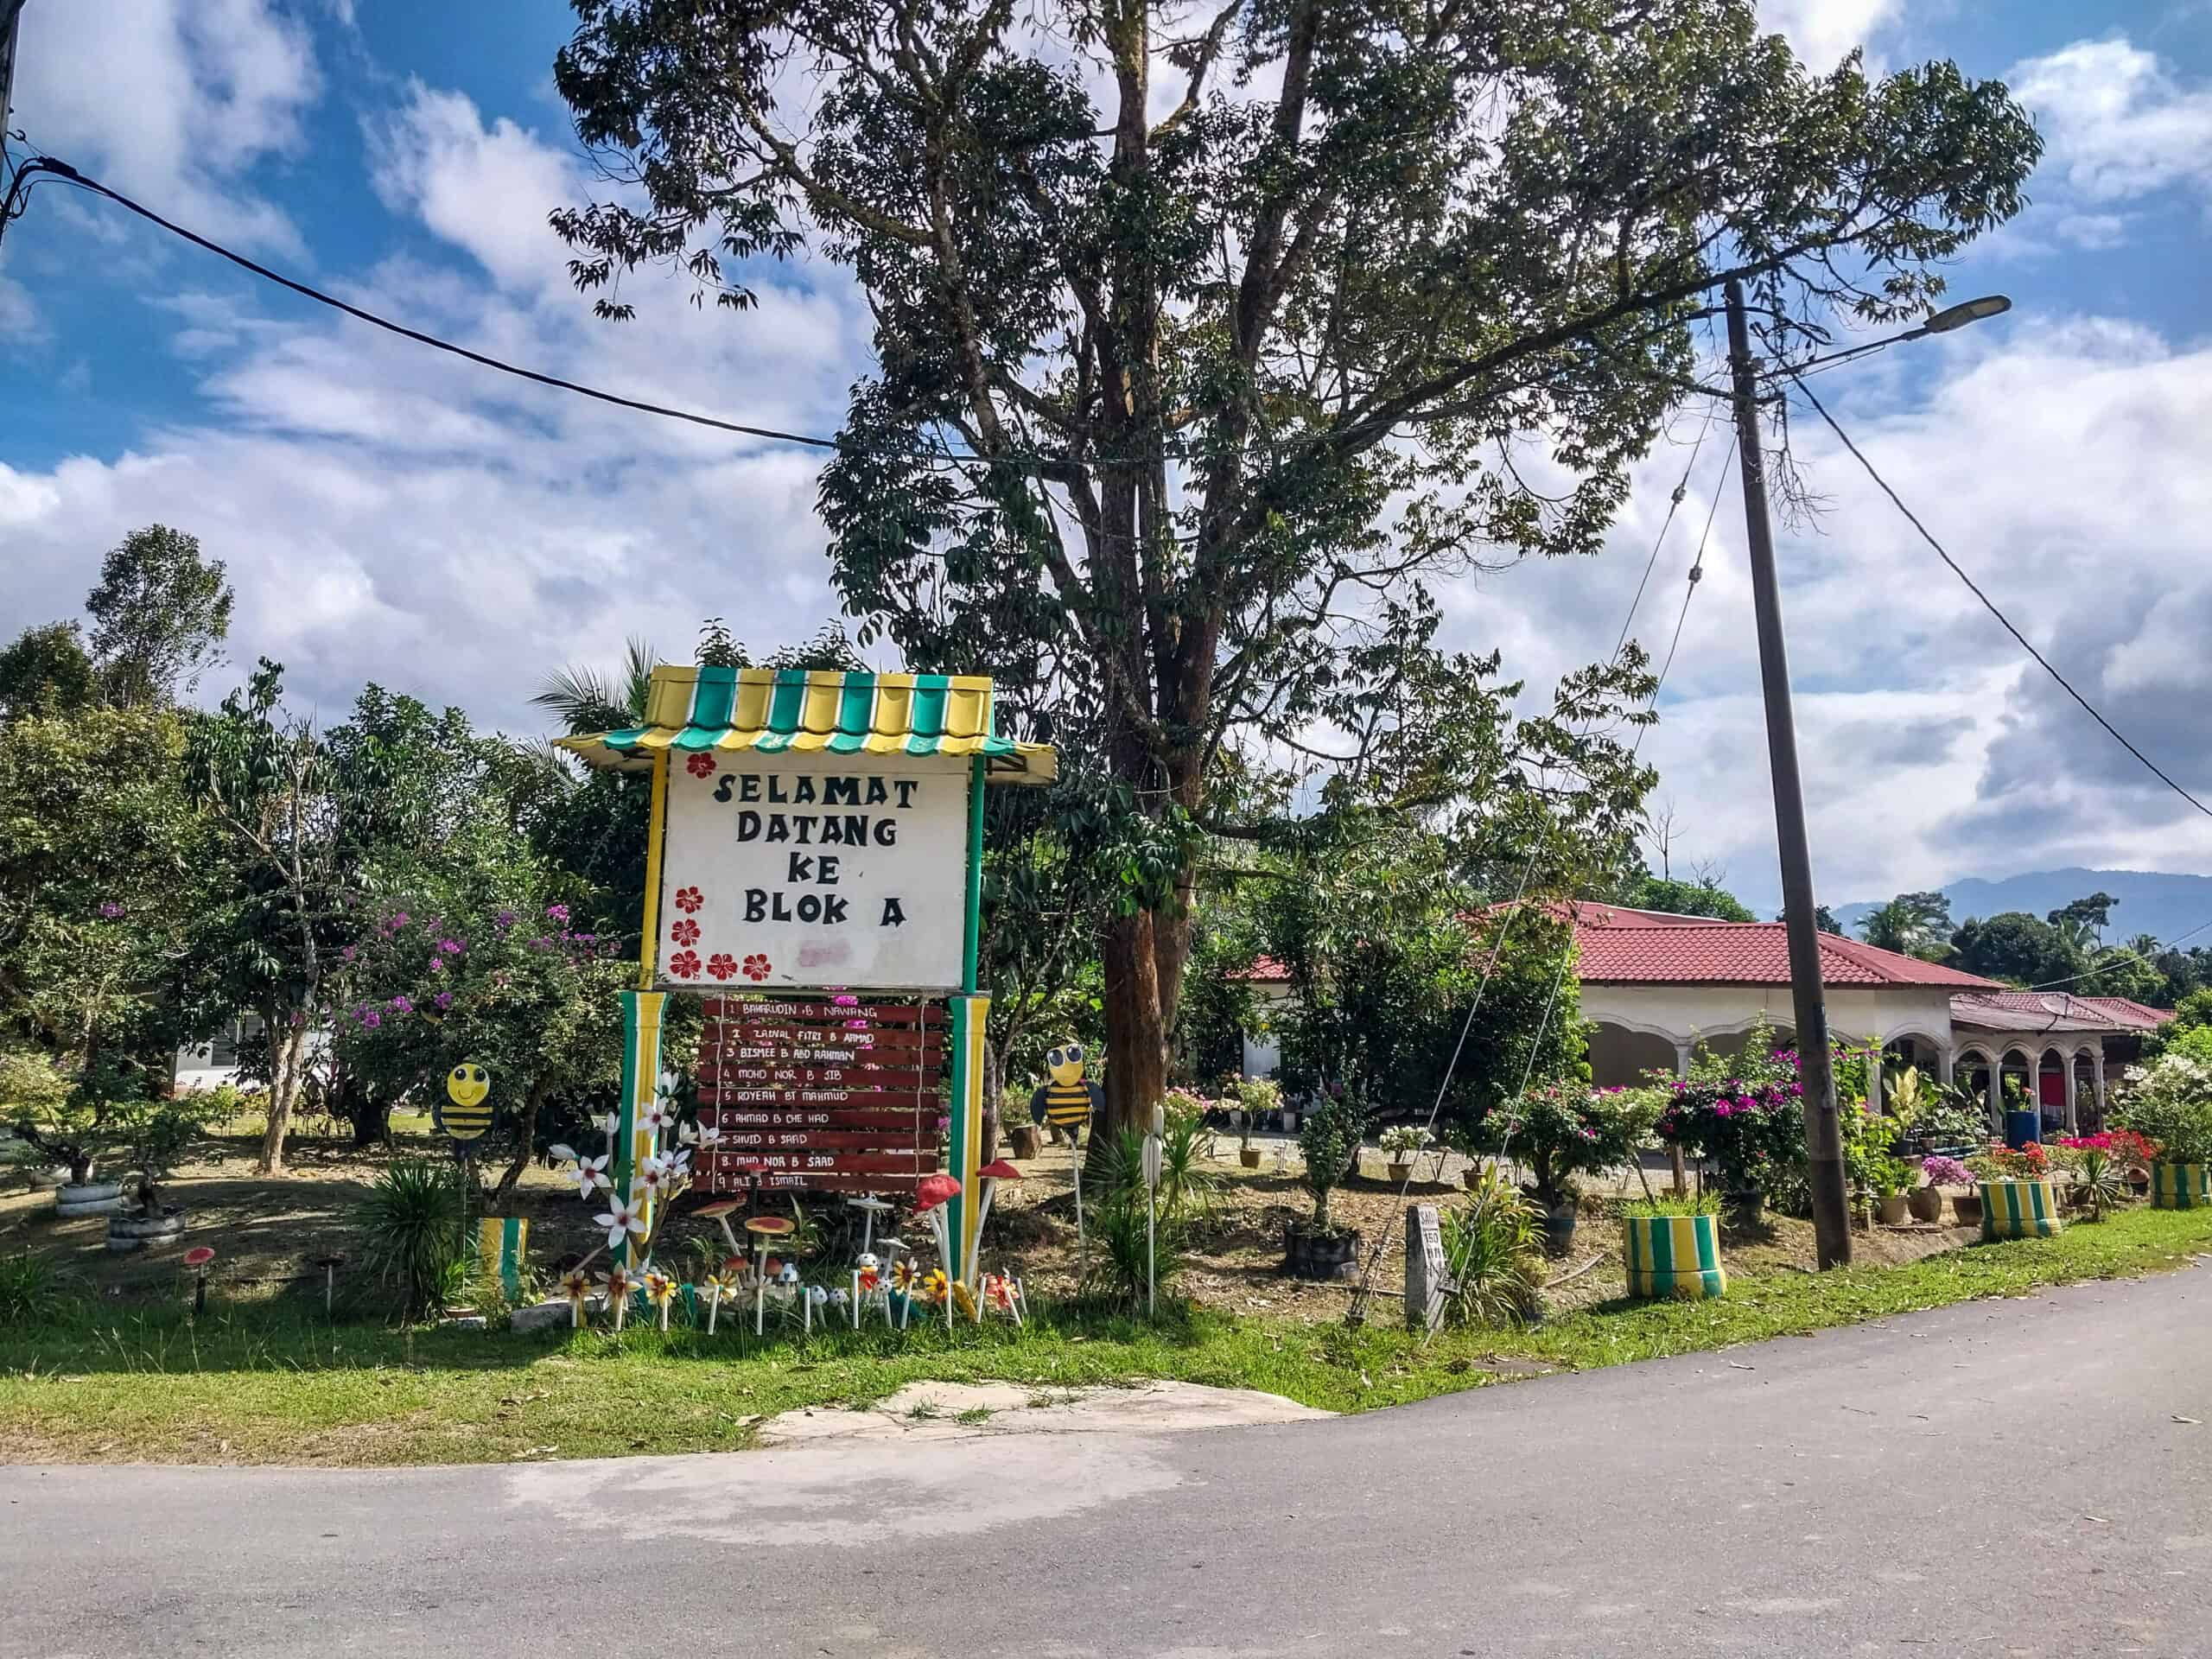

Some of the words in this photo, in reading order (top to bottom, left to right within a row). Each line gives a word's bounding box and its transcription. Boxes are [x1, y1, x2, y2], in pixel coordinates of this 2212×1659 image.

[713, 774, 918, 808] SELAMAT
[737, 811, 897, 846] DATANG
[788, 853, 840, 884] KE
[743, 889, 849, 925] BLOK
[880, 898, 906, 926] A
[743, 1005, 797, 1015] BAHARUDIN
[824, 1007, 877, 1018] NAWANG
[798, 1033, 821, 1041] FITRI
[843, 1033, 874, 1042] AHMAD
[741, 1049, 775, 1058] BISMEE
[781, 1049, 788, 1058] B
[794, 1049, 810, 1058] ABD
[814, 1049, 855, 1060] RAHMAN
[739, 1070, 767, 1078] MOHD
[775, 1071, 797, 1079] NOR
[807, 1071, 814, 1080] B
[785, 1092, 795, 1101] BT
[802, 1092, 848, 1101] MAHMUD
[722, 1115, 728, 1123] 6
[736, 1114, 768, 1123] AHMAD
[774, 1115, 781, 1123] B
[809, 1115, 829, 1123] HAD
[768, 1135, 775, 1144] B
[781, 1135, 807, 1144] SAAD
[764, 1158, 785, 1167] NOR
[791, 1159, 798, 1167] B
[807, 1158, 834, 1166] SAAD
[719, 1176, 725, 1189] 9
[770, 1176, 808, 1186] ISMAIL
